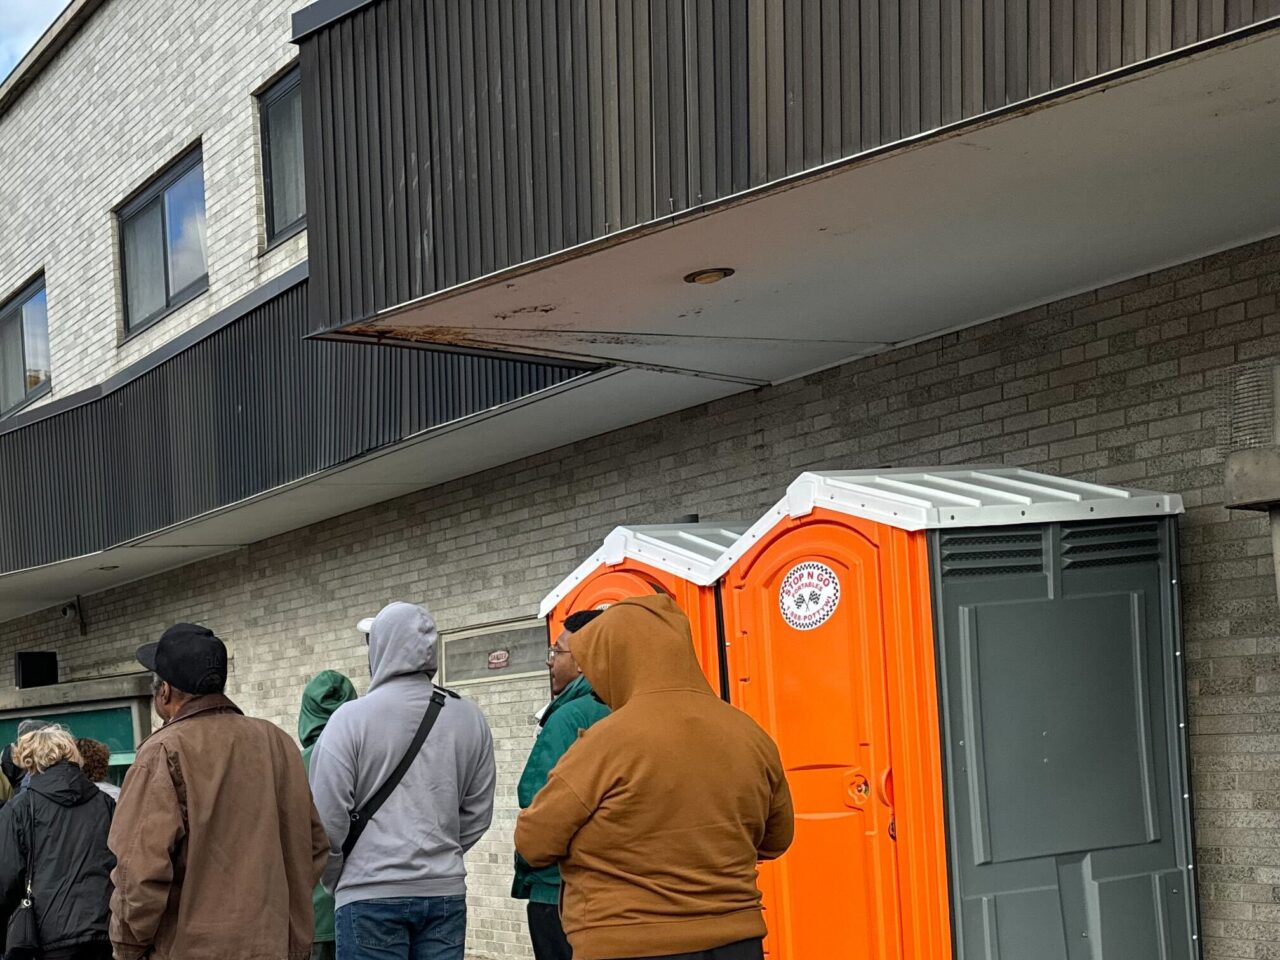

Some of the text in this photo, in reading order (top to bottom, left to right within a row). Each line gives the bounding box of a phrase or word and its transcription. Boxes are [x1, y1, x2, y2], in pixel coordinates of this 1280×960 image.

[785, 571, 830, 597] STOP N GO
[791, 581, 823, 598] PORTABLES
